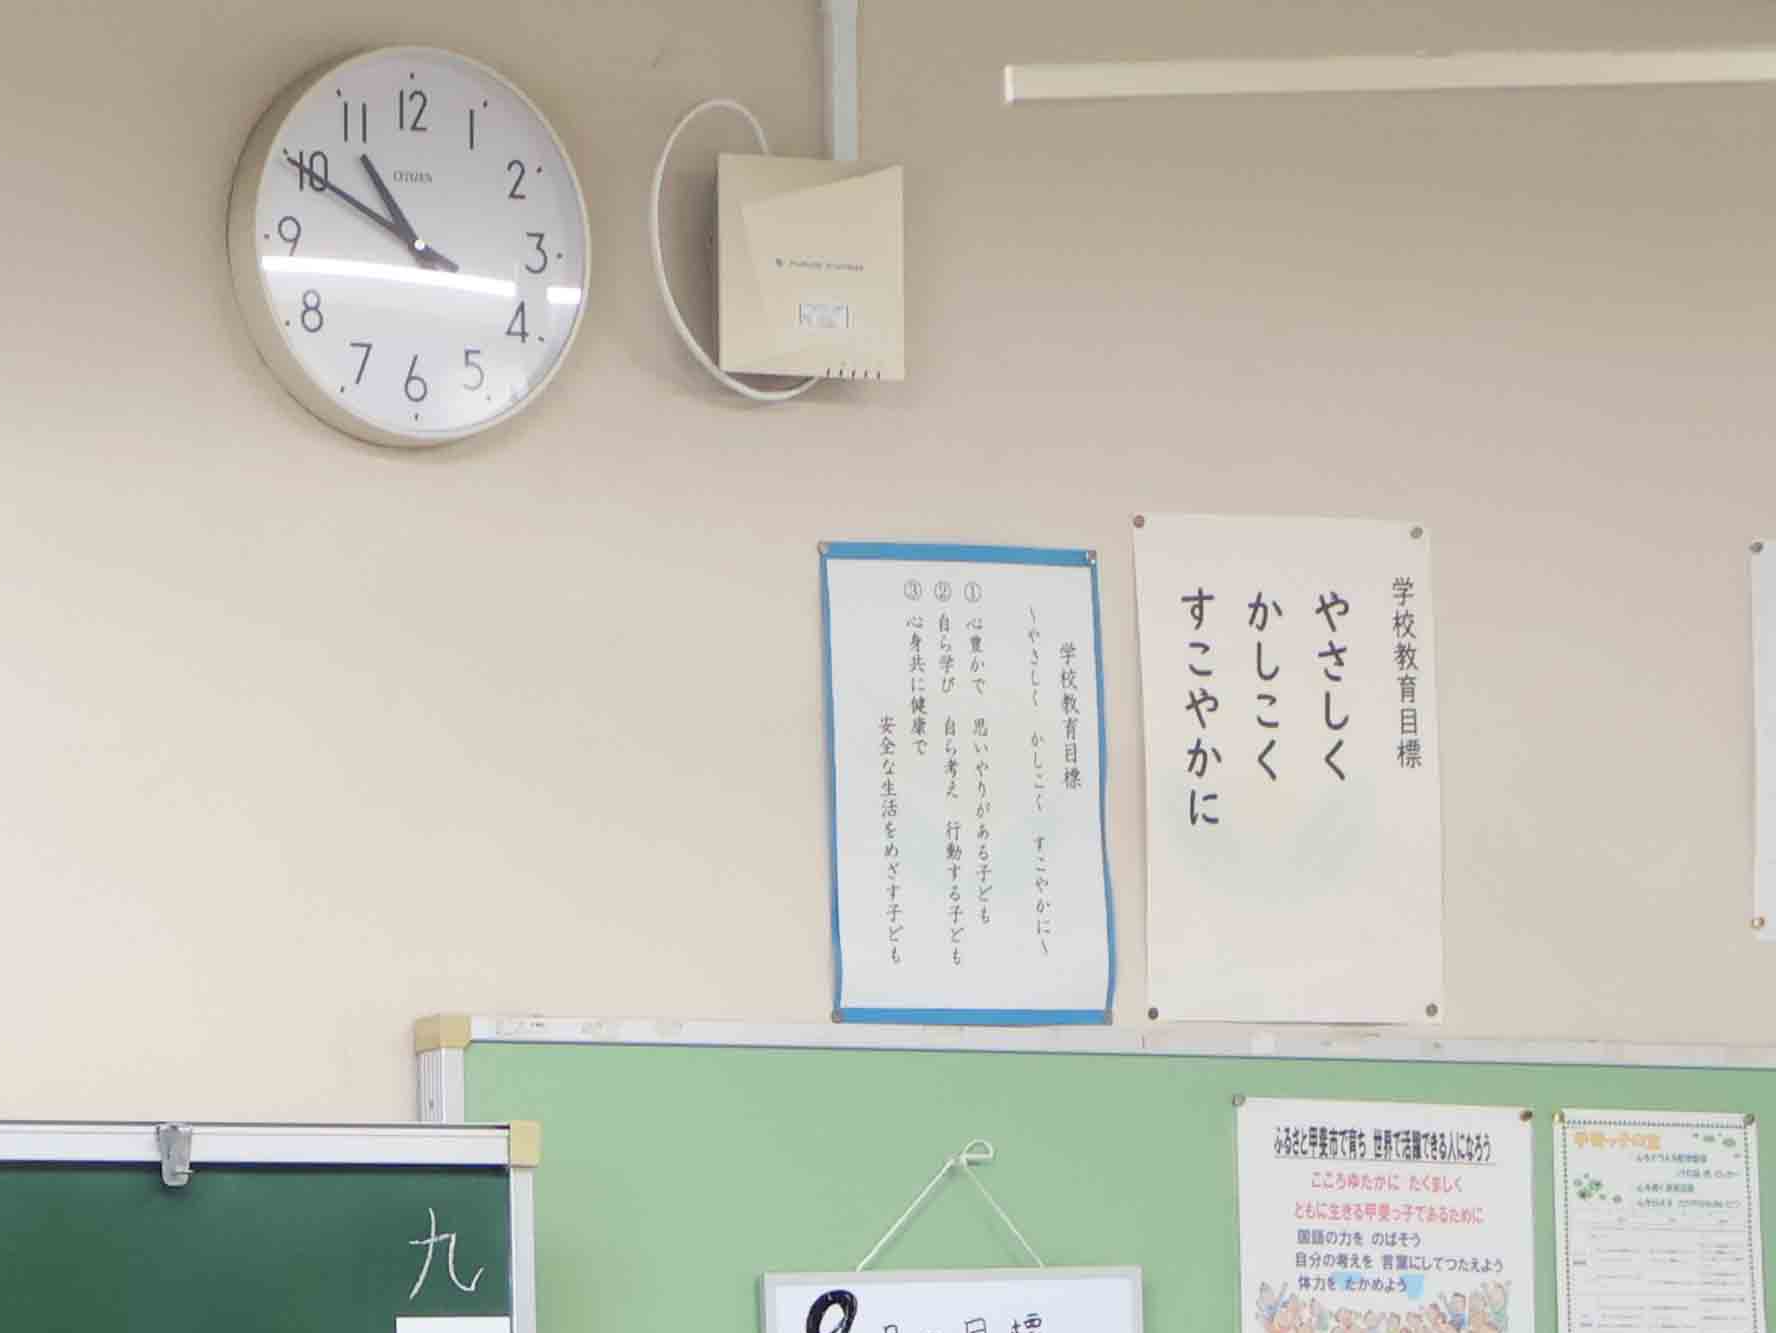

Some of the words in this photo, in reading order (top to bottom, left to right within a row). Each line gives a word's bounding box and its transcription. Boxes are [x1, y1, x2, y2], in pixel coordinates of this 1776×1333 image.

[343, 101, 367, 143] 11
[399, 90, 428, 132] 12
[468, 109, 476, 149] 1
[296, 151, 330, 193] 10
[508, 160, 527, 199] 2
[277, 216, 302, 258] 9
[526, 232, 547, 274] 3
[301, 290, 324, 333] 8
[506, 302, 529, 343] 4
[349, 343, 372, 385] 7
[405, 356, 427, 402] 6
[463, 351, 486, 391] 5
[1247, 592, 1284, 782] かしこく
[1316, 592, 1351, 782] やさしく
[1392, 575, 1422, 769] 学校教育目標
[1059, 642, 1082, 789] 学校教育目標
[1181, 588, 1222, 827] すこやかに
[879, 714, 904, 966] 安全な生活をめざす子ども
[946, 820, 964, 967] 行動する子ども
[1274, 1127, 1366, 1159] ふるさと甲斐市で育ち
[1374, 1129, 1491, 1161] 世界で活躍できる人になろう
[1312, 1171, 1399, 1191] こころゆたかに
[1409, 1175, 1463, 1193] たくましく
[1371, 1232, 1422, 1248] のばそう
[1296, 1252, 1374, 1270] 自分の考えを
[1381, 1254, 1504, 1274] 言葉にしてつたえよう
